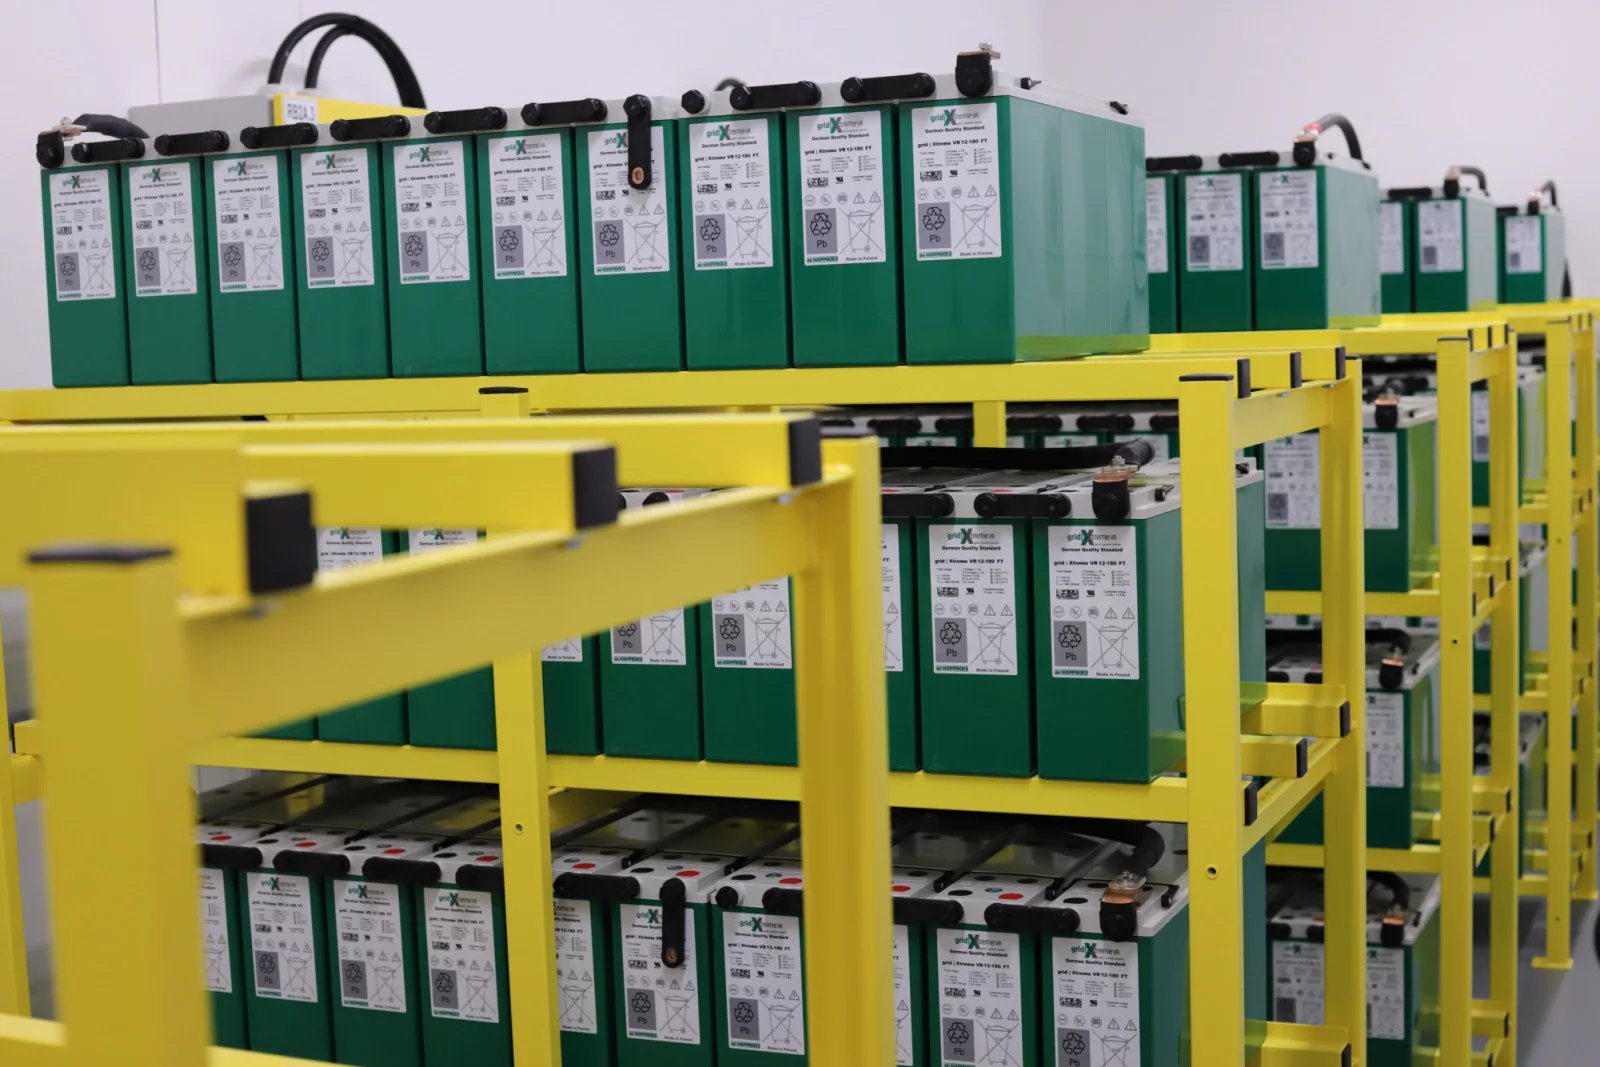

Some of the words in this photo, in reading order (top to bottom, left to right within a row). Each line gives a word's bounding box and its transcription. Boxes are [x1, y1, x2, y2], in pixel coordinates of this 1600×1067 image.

[929, 233, 941, 242] Pb
[816, 239, 827, 248] Pb
[706, 244, 717, 253] Pb
[623, 640, 633, 649] Pb
[726, 644, 736, 652] Pb
[946, 648, 957, 656] Pb
[1065, 652, 1077, 660] Pb
[954, 1047, 965, 1056] Pb
[1069, 1059, 1081, 1067] Pb
